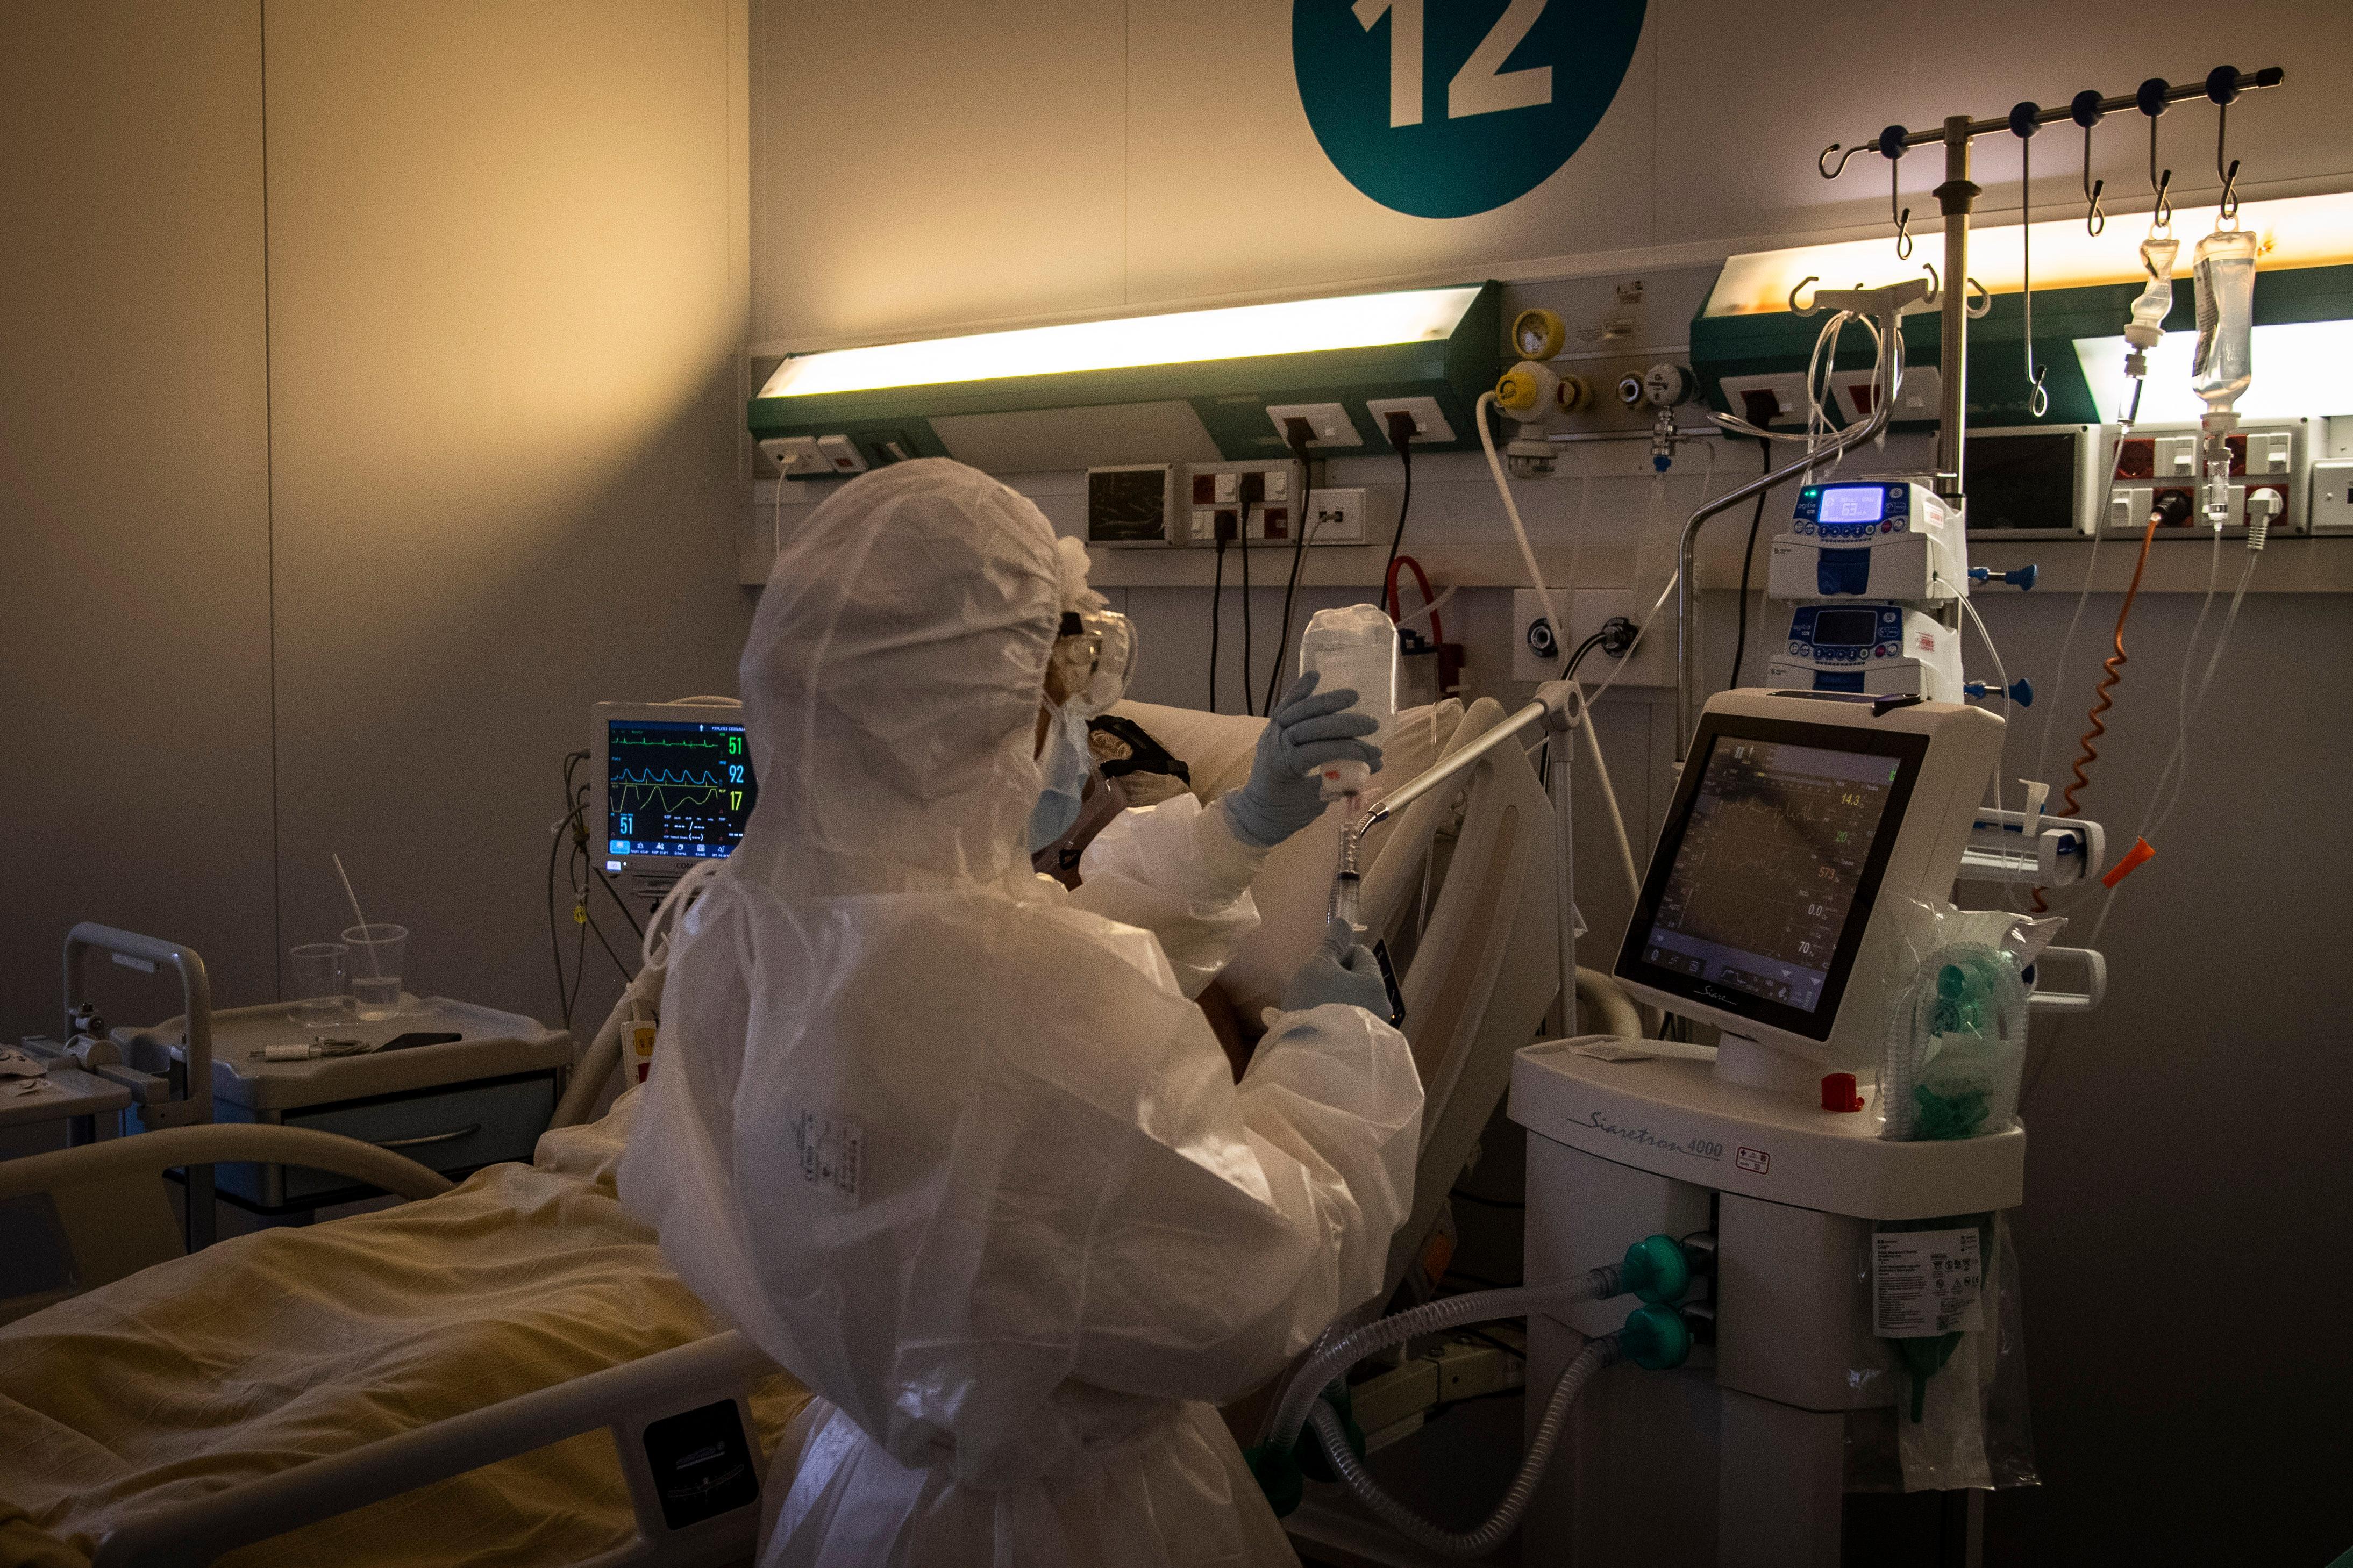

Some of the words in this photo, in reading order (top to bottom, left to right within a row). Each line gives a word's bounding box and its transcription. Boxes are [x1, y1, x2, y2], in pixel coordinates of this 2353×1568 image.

[1351, 0, 1552, 128] 12
[729, 736, 742, 755] 51
[729, 765, 744, 783] 92
[730, 791, 743, 810] 17
[1841, 793, 1861, 806] 14.3
[621, 817, 633, 834] 51
[1567, 1110, 1683, 1152] Siaretron
[1688, 1139, 1723, 1158] 4000
